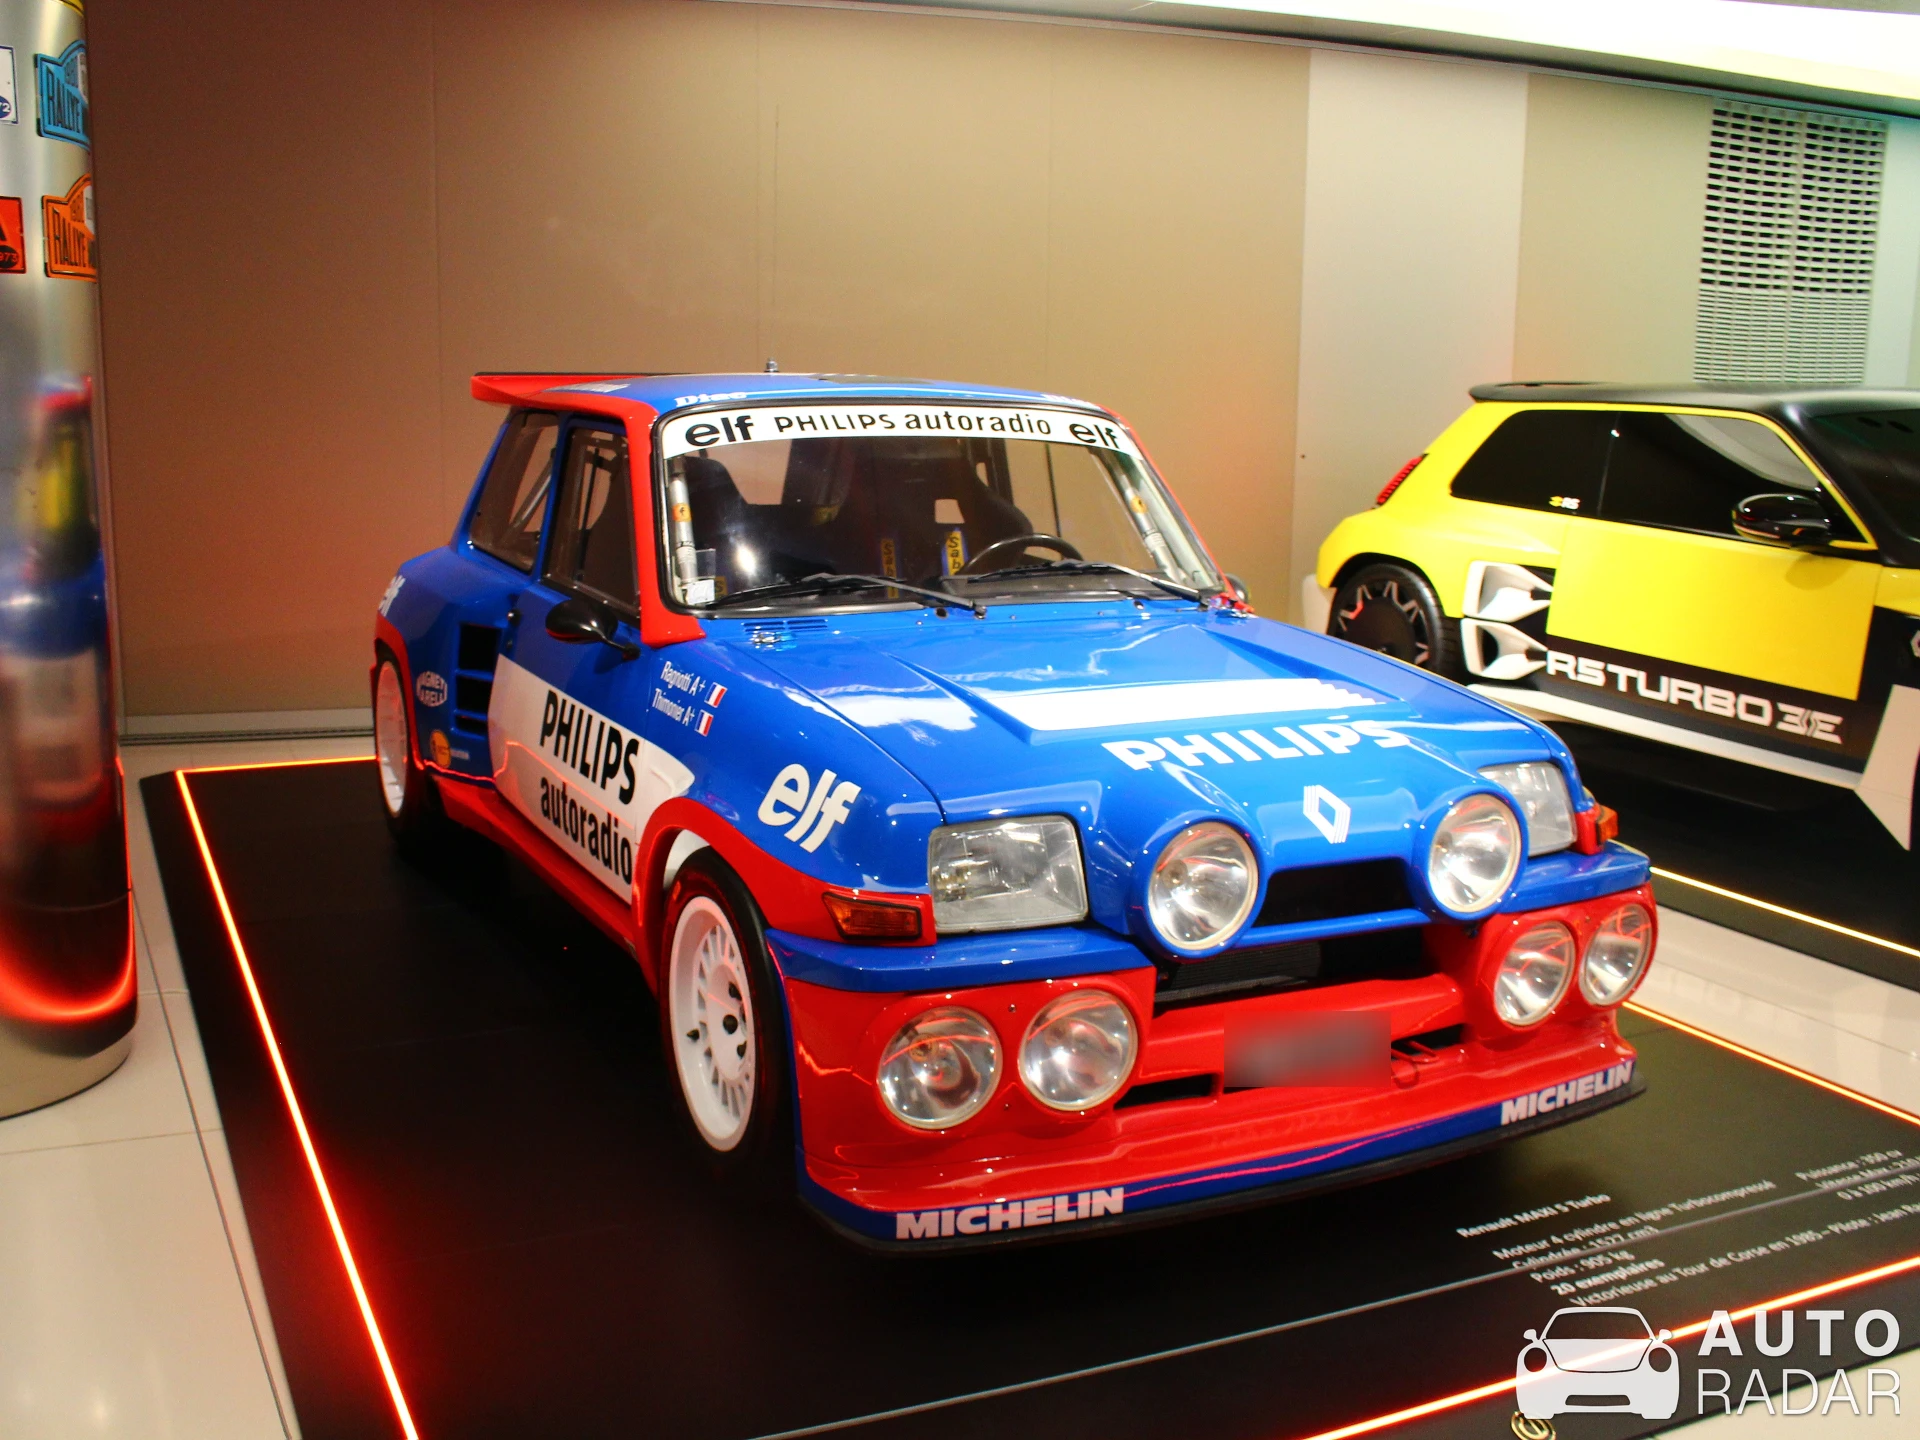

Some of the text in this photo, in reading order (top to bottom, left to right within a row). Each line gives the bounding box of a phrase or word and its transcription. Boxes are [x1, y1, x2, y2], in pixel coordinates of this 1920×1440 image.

[685, 411, 1121, 449] elf PHILIPS autoradio elf
[539, 690, 639, 805] PHILIPS
[1101, 720, 1410, 770] PHILIPS
[540, 777, 633, 885] autoradio
[757, 763, 861, 853] elf
[1501, 1060, 1633, 1125] MICHELIN
[896, 1187, 1124, 1239] MICHELIN
[1456, 1216, 1518, 1238] Renault
[1513, 1205, 1558, 1223] MAXI
[1564, 1194, 1611, 1210] Turbo
[1492, 1239, 1551, 1260] Moteur
[1672, 1261, 1711, 1278] Tour
[1726, 1246, 1771, 1262] Corse
[1530, 1264, 1576, 1283] Poids
[1550, 1281, 1577, 1296] 20
